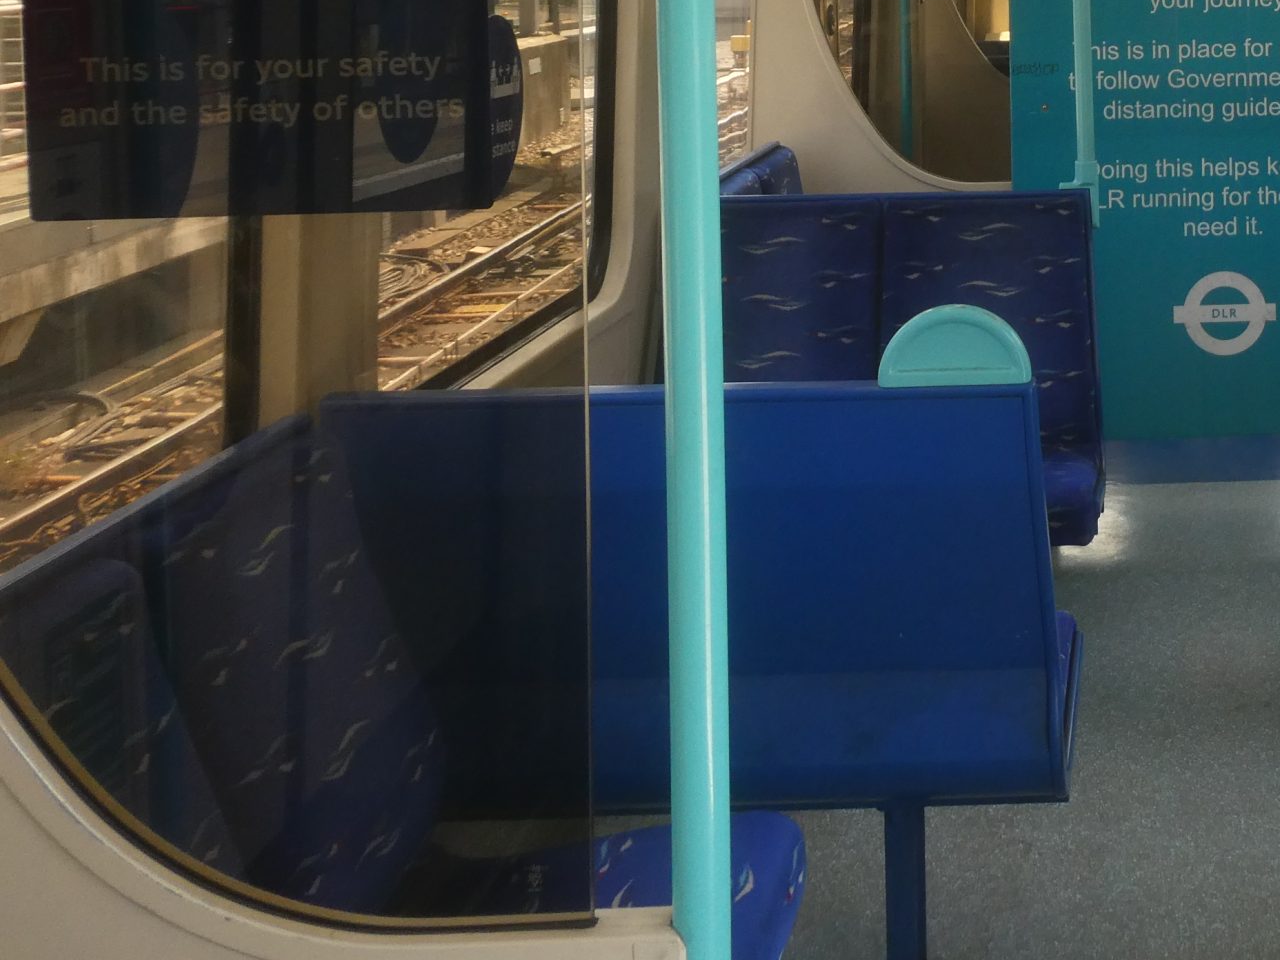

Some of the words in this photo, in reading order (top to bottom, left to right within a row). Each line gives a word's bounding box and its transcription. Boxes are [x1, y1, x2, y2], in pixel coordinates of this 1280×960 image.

[1128, 41, 1144, 59] is
[1153, 40, 1169, 58] in
[1179, 40, 1236, 62] place
[1244, 38, 1272, 56] for
[79, 57, 148, 83] This
[159, 55, 185, 81] is
[197, 53, 244, 80] for
[256, 57, 328, 86] your
[339, 52, 442, 84] safety
[1097, 71, 1160, 90] follow
[60, 100, 119, 128] and
[132, 99, 187, 126] the
[198, 97, 300, 128] safety
[313, 94, 348, 120] of
[358, 92, 465, 120] others
[1104, 99, 1213, 122] distancing
[1156, 159, 1193, 177] this
[1202, 158, 1259, 180] helps
[1133, 188, 1214, 211] running
[1222, 187, 1251, 205] for
[1184, 217, 1236, 236] need
[1246, 217, 1262, 234] it.
[1211, 307, 1237, 319] DLR
